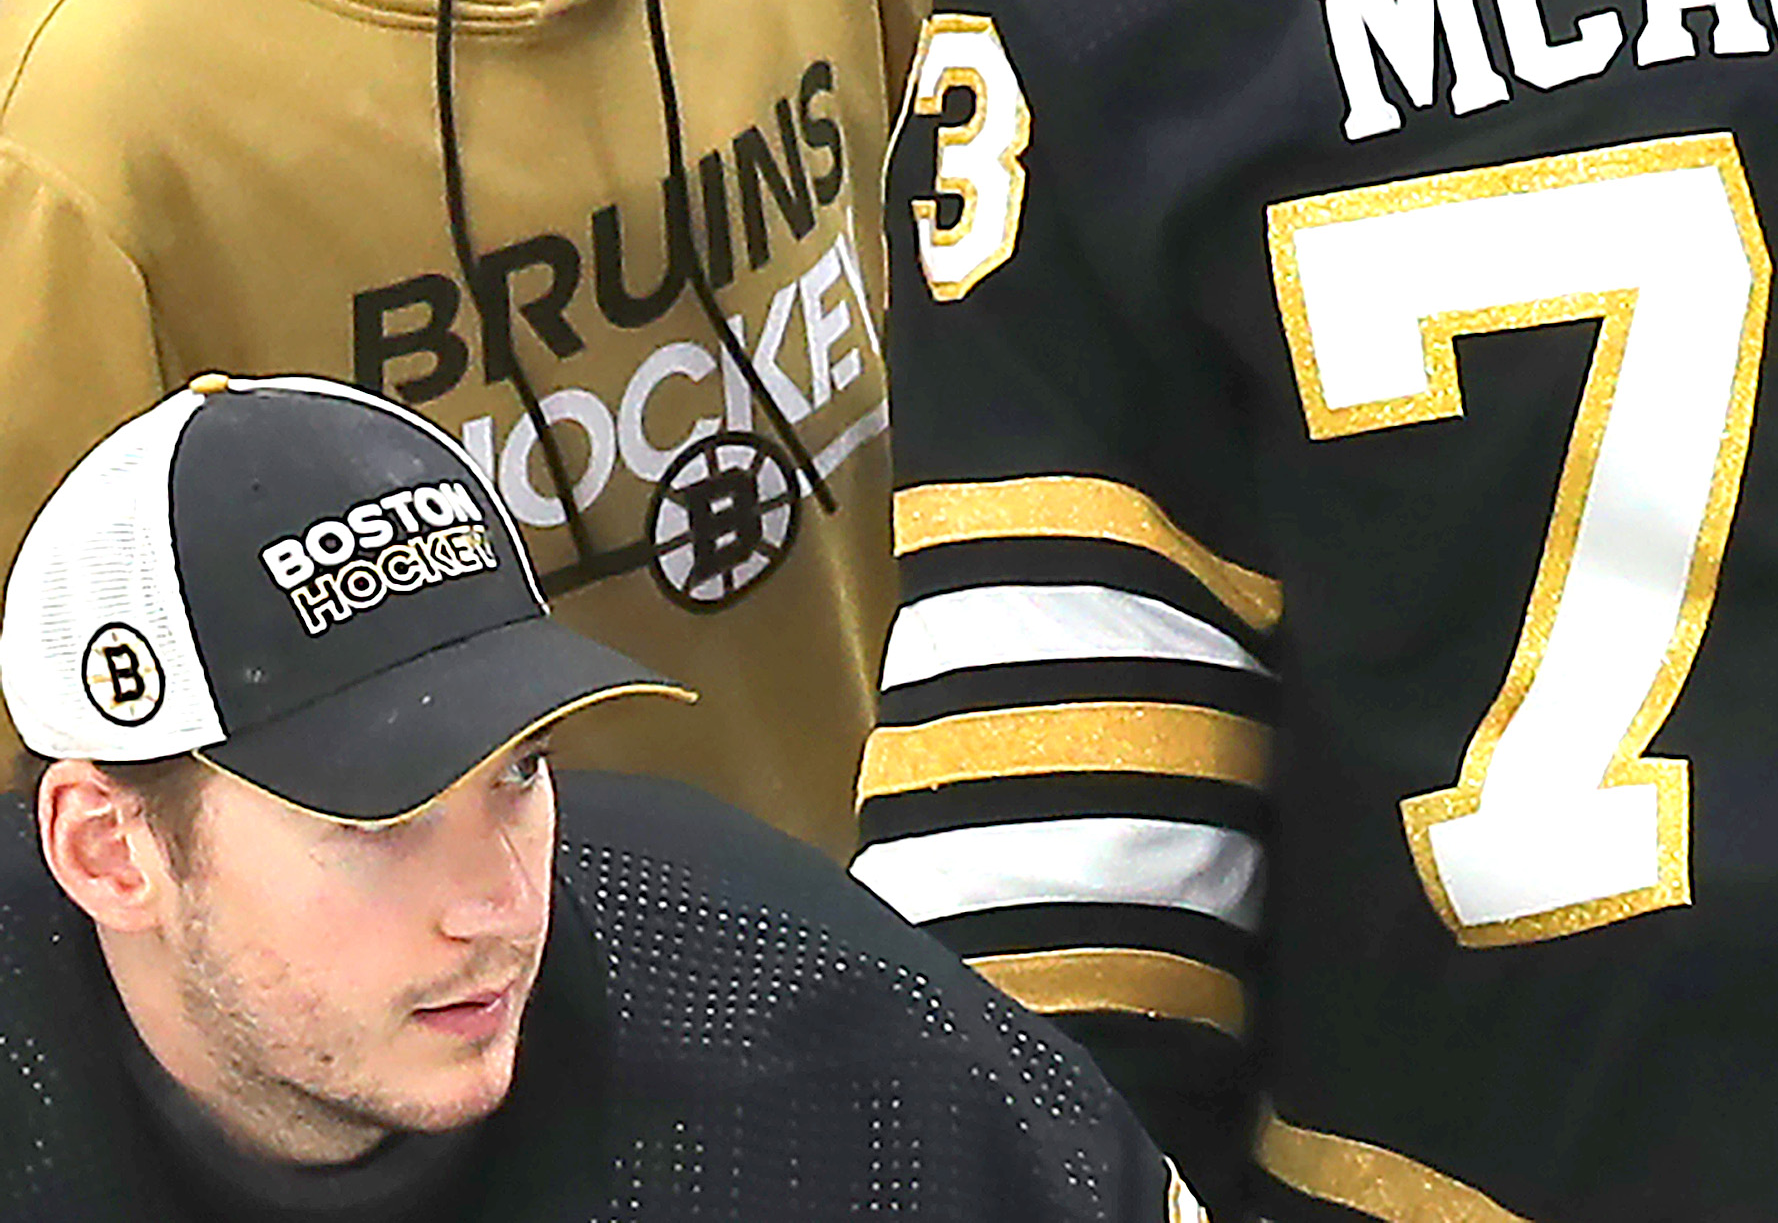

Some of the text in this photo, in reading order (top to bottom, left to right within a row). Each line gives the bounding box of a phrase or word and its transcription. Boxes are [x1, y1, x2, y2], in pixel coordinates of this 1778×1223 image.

[350, 58, 844, 407] BRUINS
[261, 482, 484, 589] BOSTON
[290, 524, 498, 635] HOCKEY
